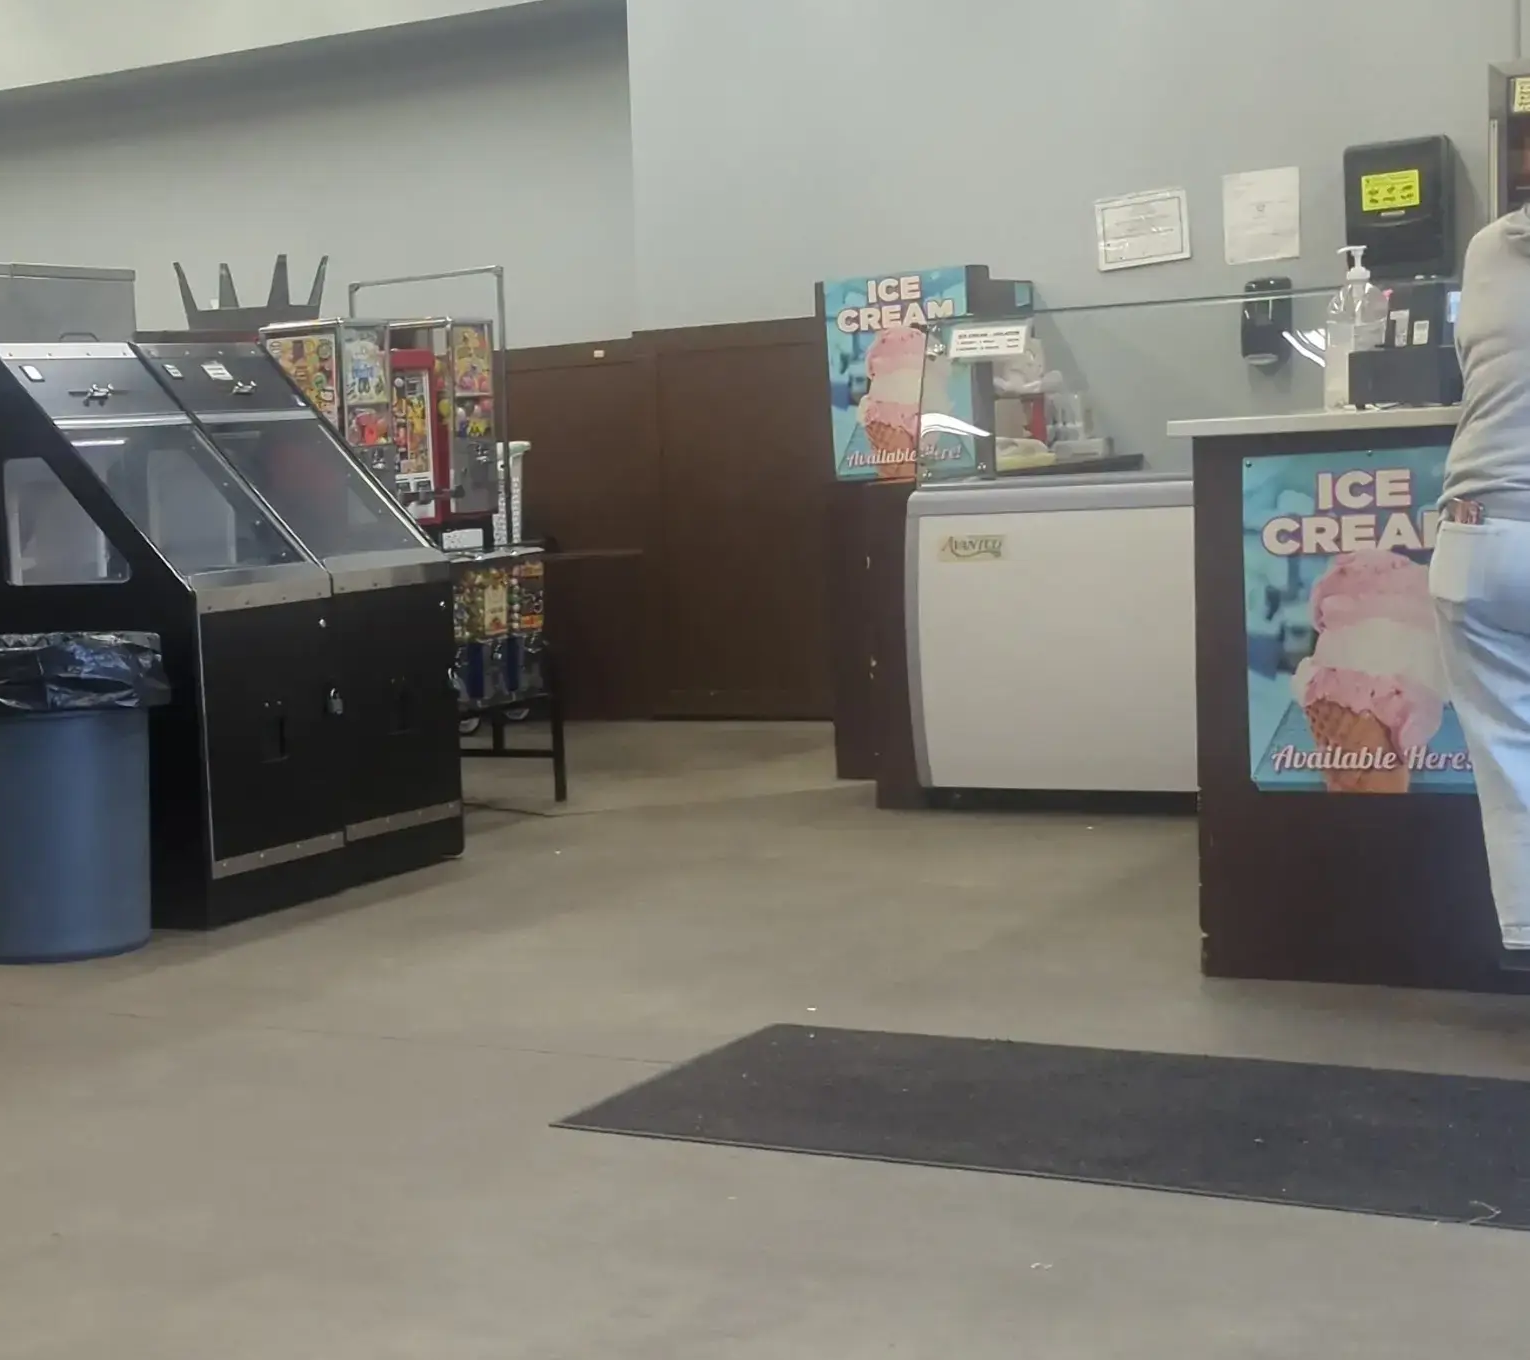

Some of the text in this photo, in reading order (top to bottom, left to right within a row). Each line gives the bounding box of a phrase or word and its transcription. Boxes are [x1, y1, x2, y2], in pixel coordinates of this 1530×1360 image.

[867, 276, 921, 304] ICE
[837, 299, 954, 333] CREAM
[847, 447, 917, 468] Available
[1318, 468, 1412, 511] ICE
[1272, 744, 1397, 771] Available
